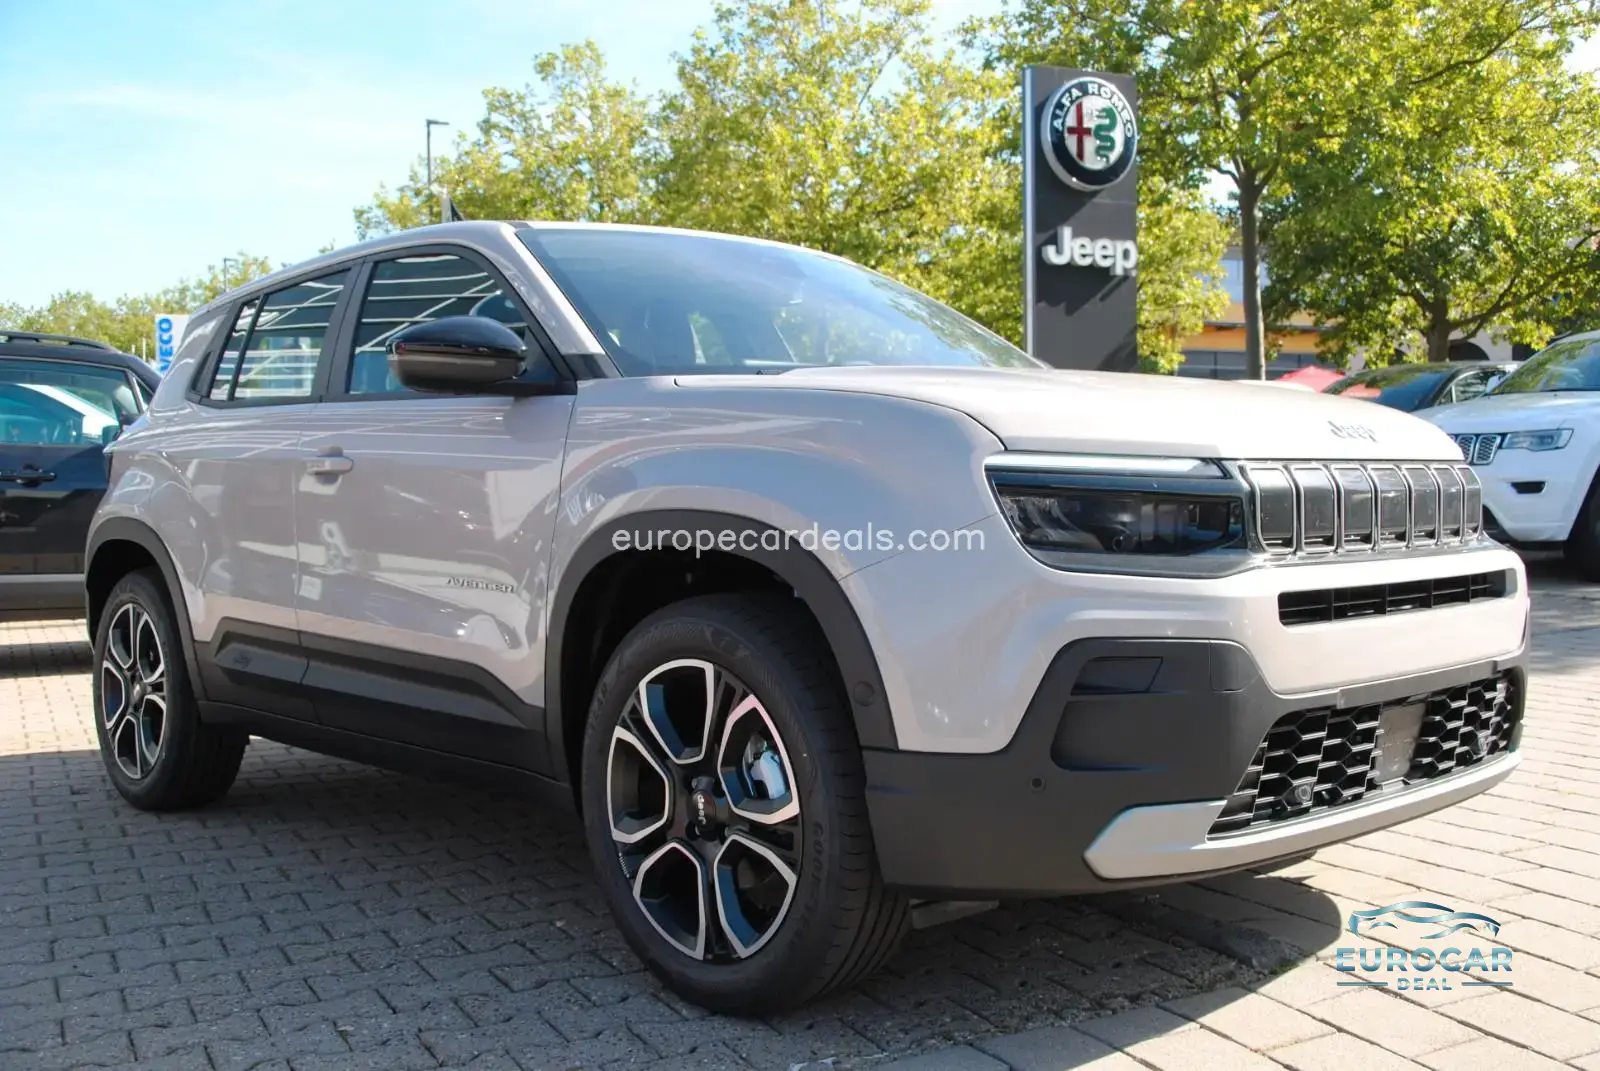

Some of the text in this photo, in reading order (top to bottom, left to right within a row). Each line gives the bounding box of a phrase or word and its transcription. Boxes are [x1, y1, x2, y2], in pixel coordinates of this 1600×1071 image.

[1052, 82, 1134, 138] ALFA ROMEO
[1042, 226, 1138, 276] Jeep
